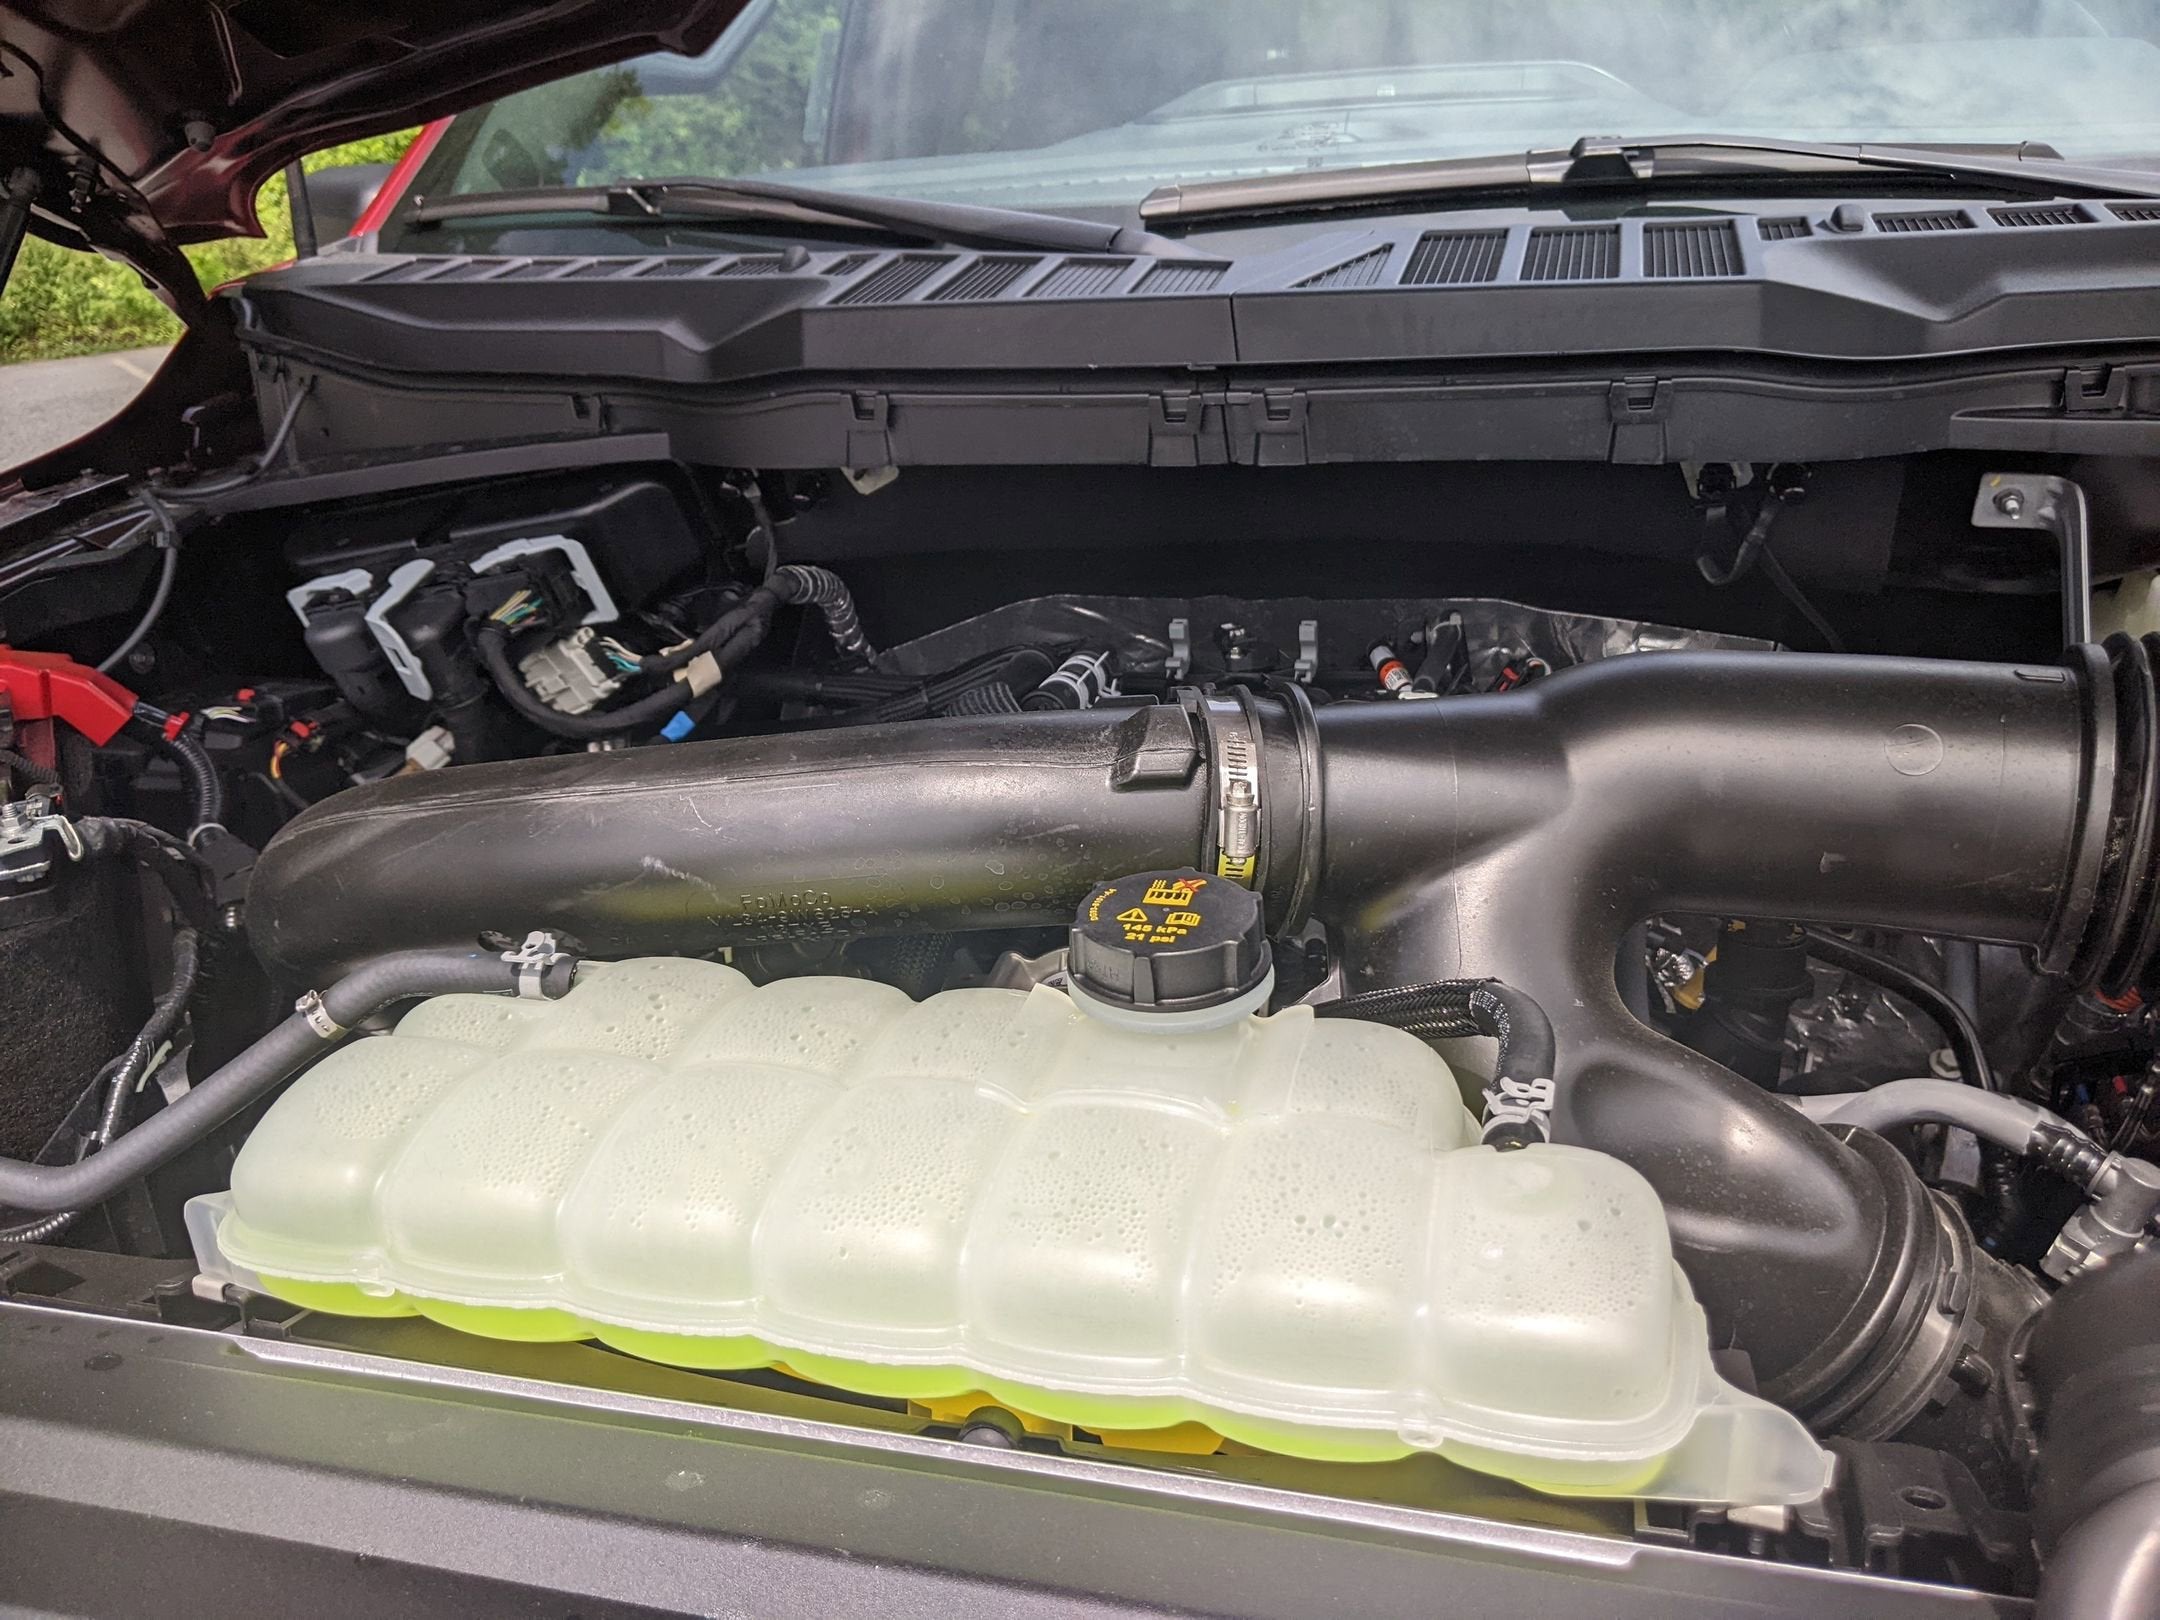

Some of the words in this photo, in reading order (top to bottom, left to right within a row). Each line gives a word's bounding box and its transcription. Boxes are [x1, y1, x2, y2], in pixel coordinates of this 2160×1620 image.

[740, 889, 832, 909] FoMoCo
[1122, 923, 1153, 932] 145
[1156, 925, 1187, 935] kPa
[1124, 932, 1145, 941] 21
[1149, 935, 1176, 943] psi
